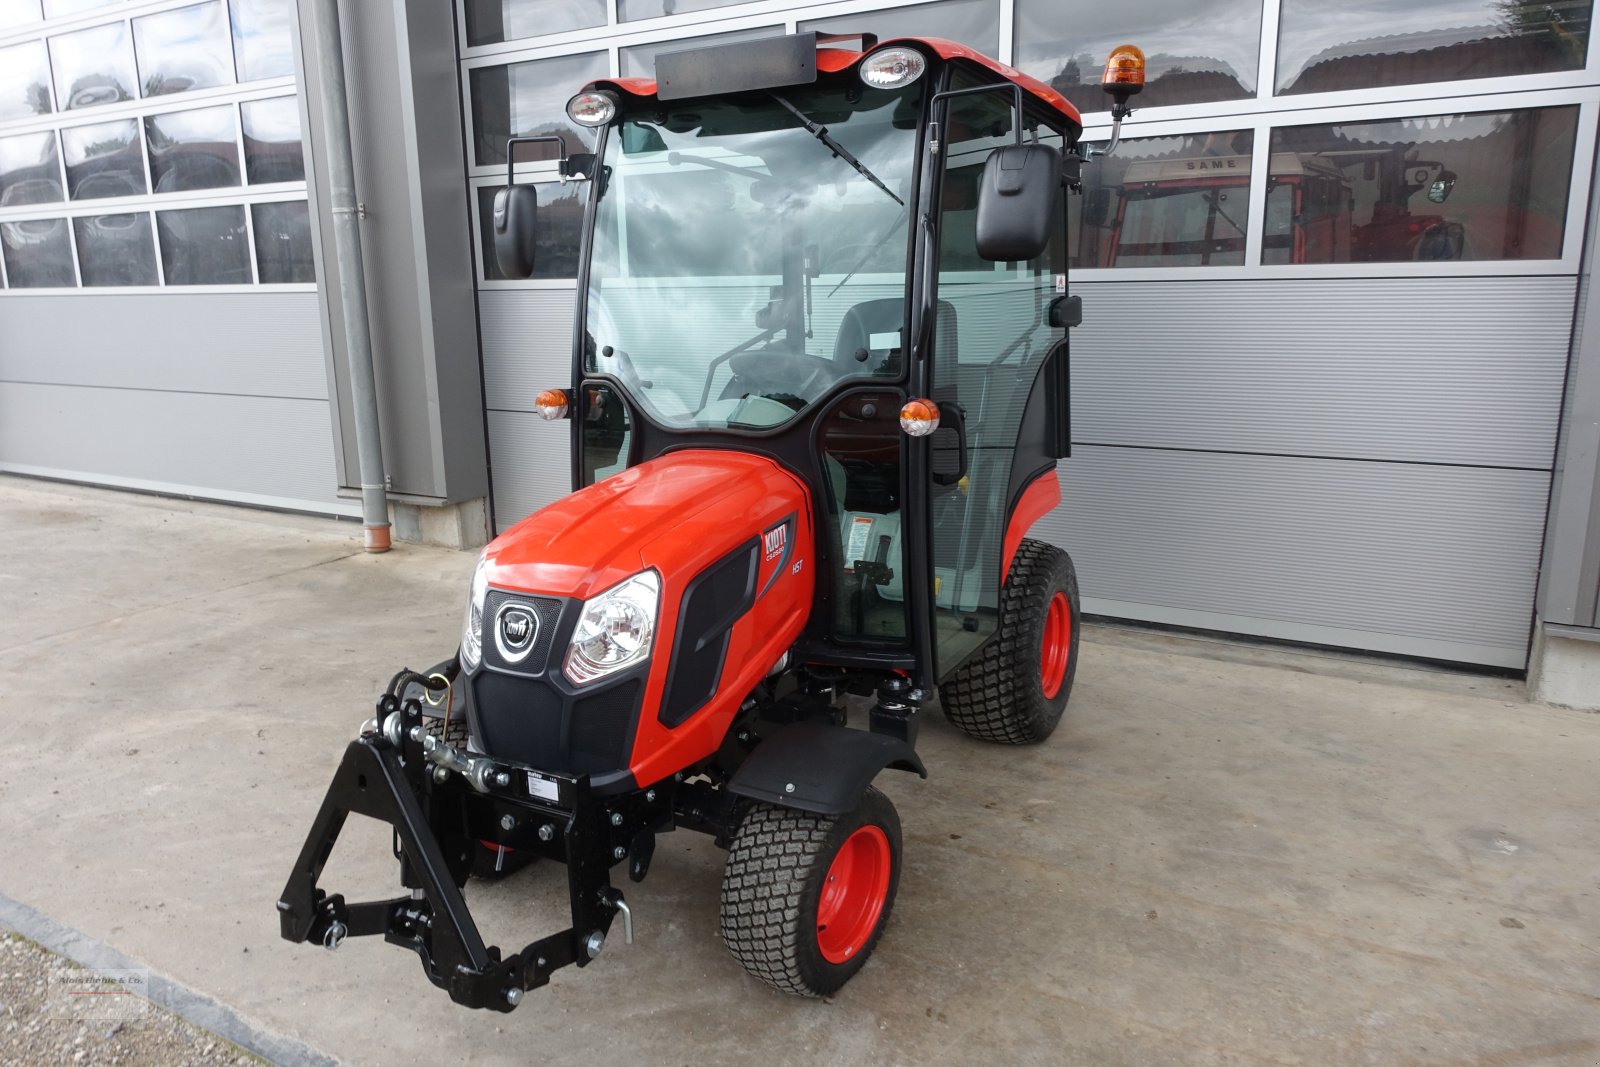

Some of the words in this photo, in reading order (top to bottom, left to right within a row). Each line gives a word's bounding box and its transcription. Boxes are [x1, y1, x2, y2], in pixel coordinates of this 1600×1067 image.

[1187, 160, 1236, 170] SAME
[765, 524, 787, 555] KIOTI
[792, 560, 804, 576] HST
